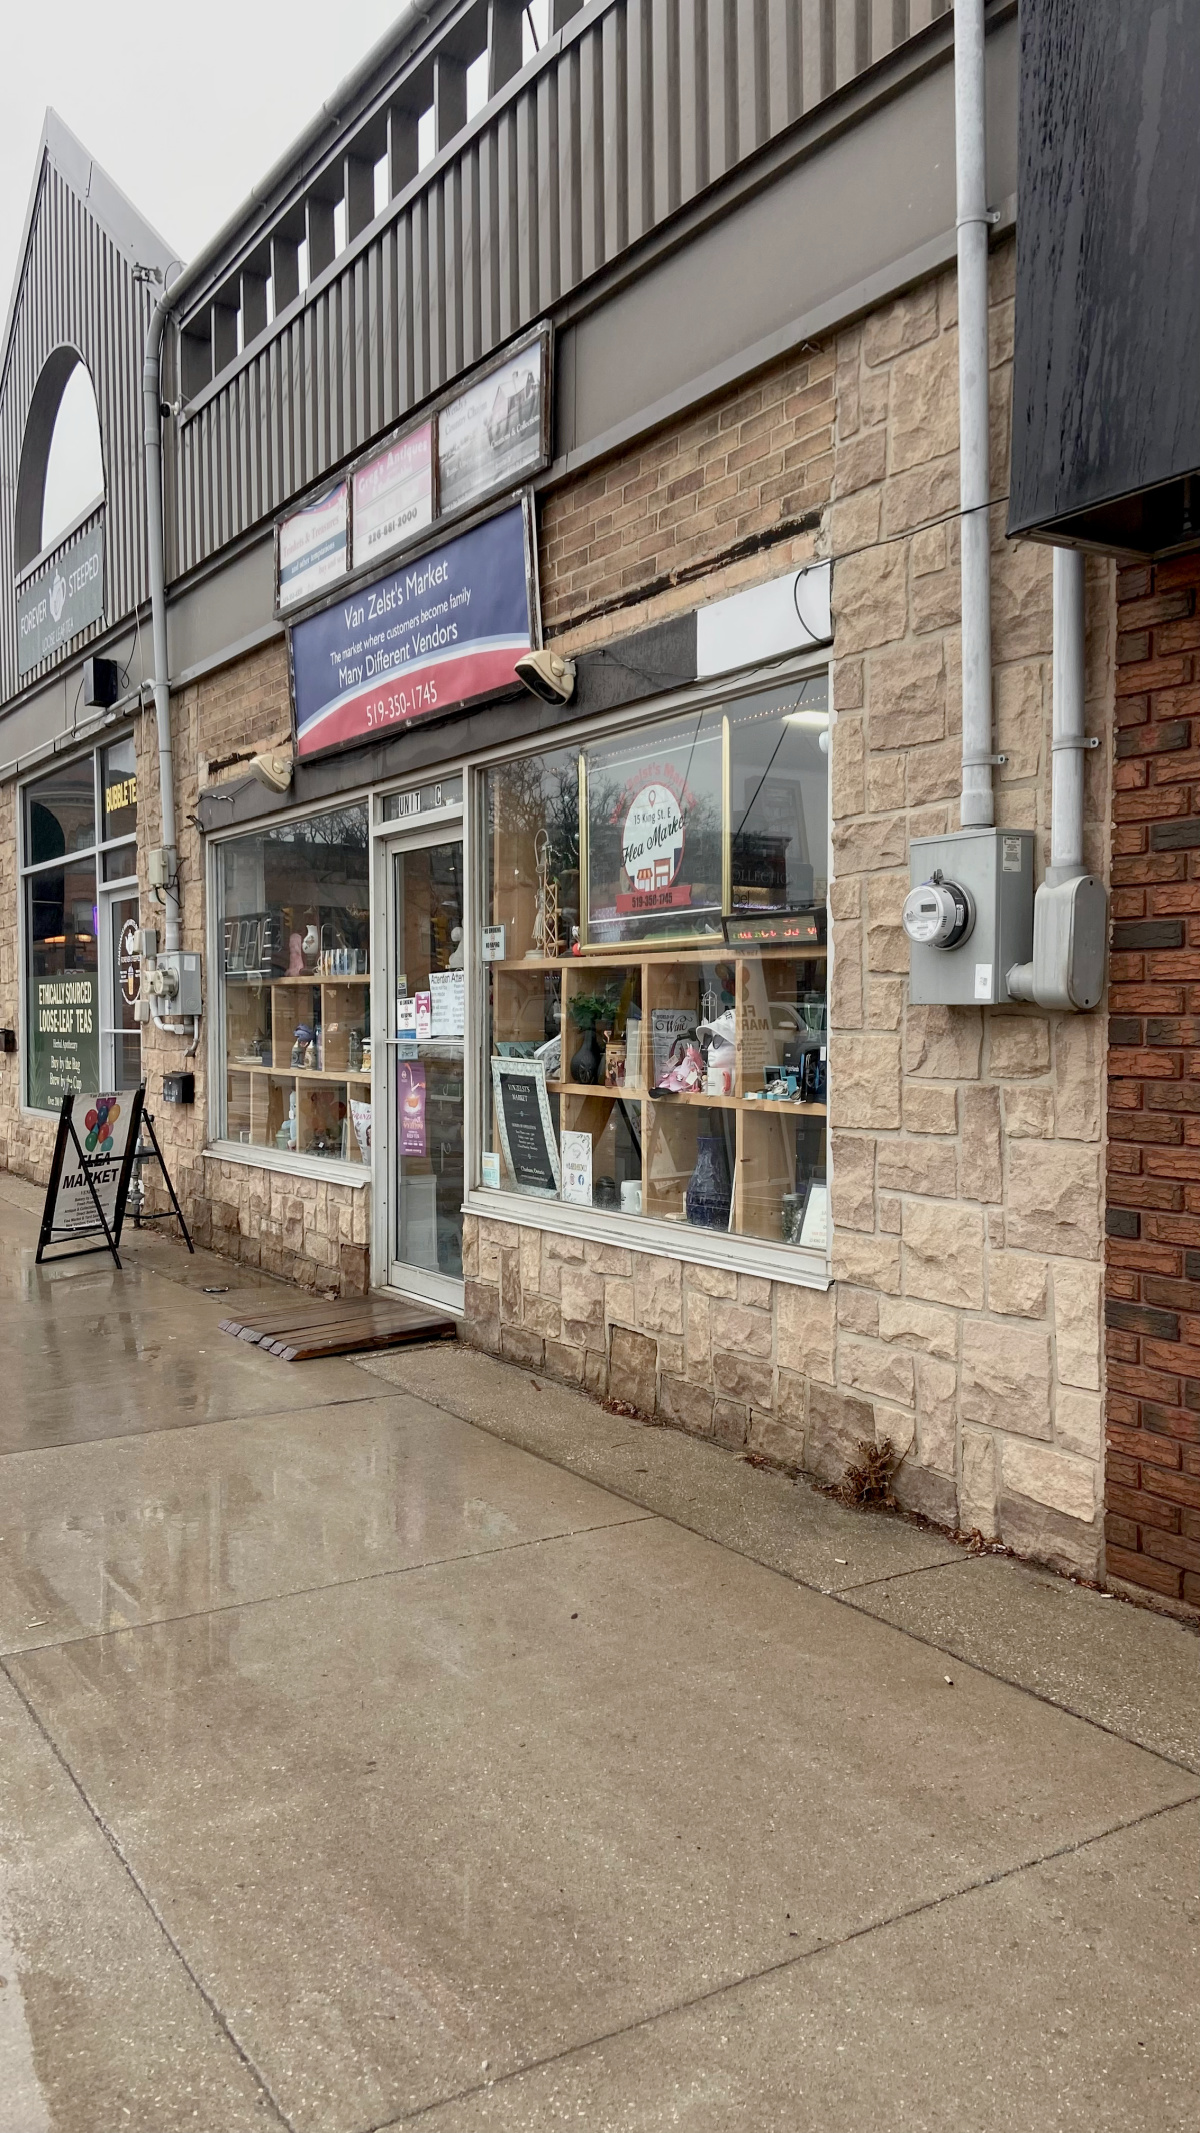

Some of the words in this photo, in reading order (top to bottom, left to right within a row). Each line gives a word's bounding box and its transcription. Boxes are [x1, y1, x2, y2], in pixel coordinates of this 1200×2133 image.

[359, 461, 384, 492] Greg's
[387, 440, 427, 470] Antiques
[283, 537, 304, 558] Trinkets
[312, 515, 339, 540] Treasures
[368, 507, 418, 545] 226-881-2000
[300, 556, 310, 569] other
[20, 598, 47, 638] FOREVER
[68, 553, 98, 598] STEEPED
[344, 605, 364, 631] Van
[368, 581, 403, 620] Zelst's
[405, 559, 448, 600] Market
[330, 652, 342, 666] The
[342, 641, 362, 660] market
[364, 632, 385, 650] where
[386, 615, 420, 640] customers
[420, 601, 448, 624] become
[450, 586, 472, 610] family
[42, 634, 55, 653] LOOSE
[339, 663, 363, 688] Many
[366, 641, 410, 676] Different
[412, 622, 458, 656] Vendors
[366, 680, 438, 726] 519-350-1745
[106, 780, 128, 814] BUBBLE
[128, 777, 137, 804] TE
[400, 792, 420, 815] UNIT
[436, 786, 440, 804] C
[634, 814, 641, 825] 15
[642, 812, 655, 826] King
[657, 808, 666, 821] St.
[667, 806, 671, 819] E
[621, 843, 644, 868] Flea
[647, 808, 688, 850] Market
[451, 973, 464, 982] Atten
[38, 983, 65, 1005] ETHICALLY
[65, 981, 92, 1004] SOURCED
[39, 1009, 74, 1033] LOOSE-LEAF
[75, 1008, 93, 1034] TEAS
[656, 1018, 688, 1033] Wine
[51, 1055, 59, 1072] Buy
[60, 1056, 64, 1072] by
[72, 1057, 80, 1074] Bag
[50, 1072, 60, 1085] Brew
[61, 1074, 65, 1091] by
[73, 1076, 82, 1093] Cup
[78, 1152, 112, 1169] FLEA
[62, 1168, 119, 1189] MARKET
